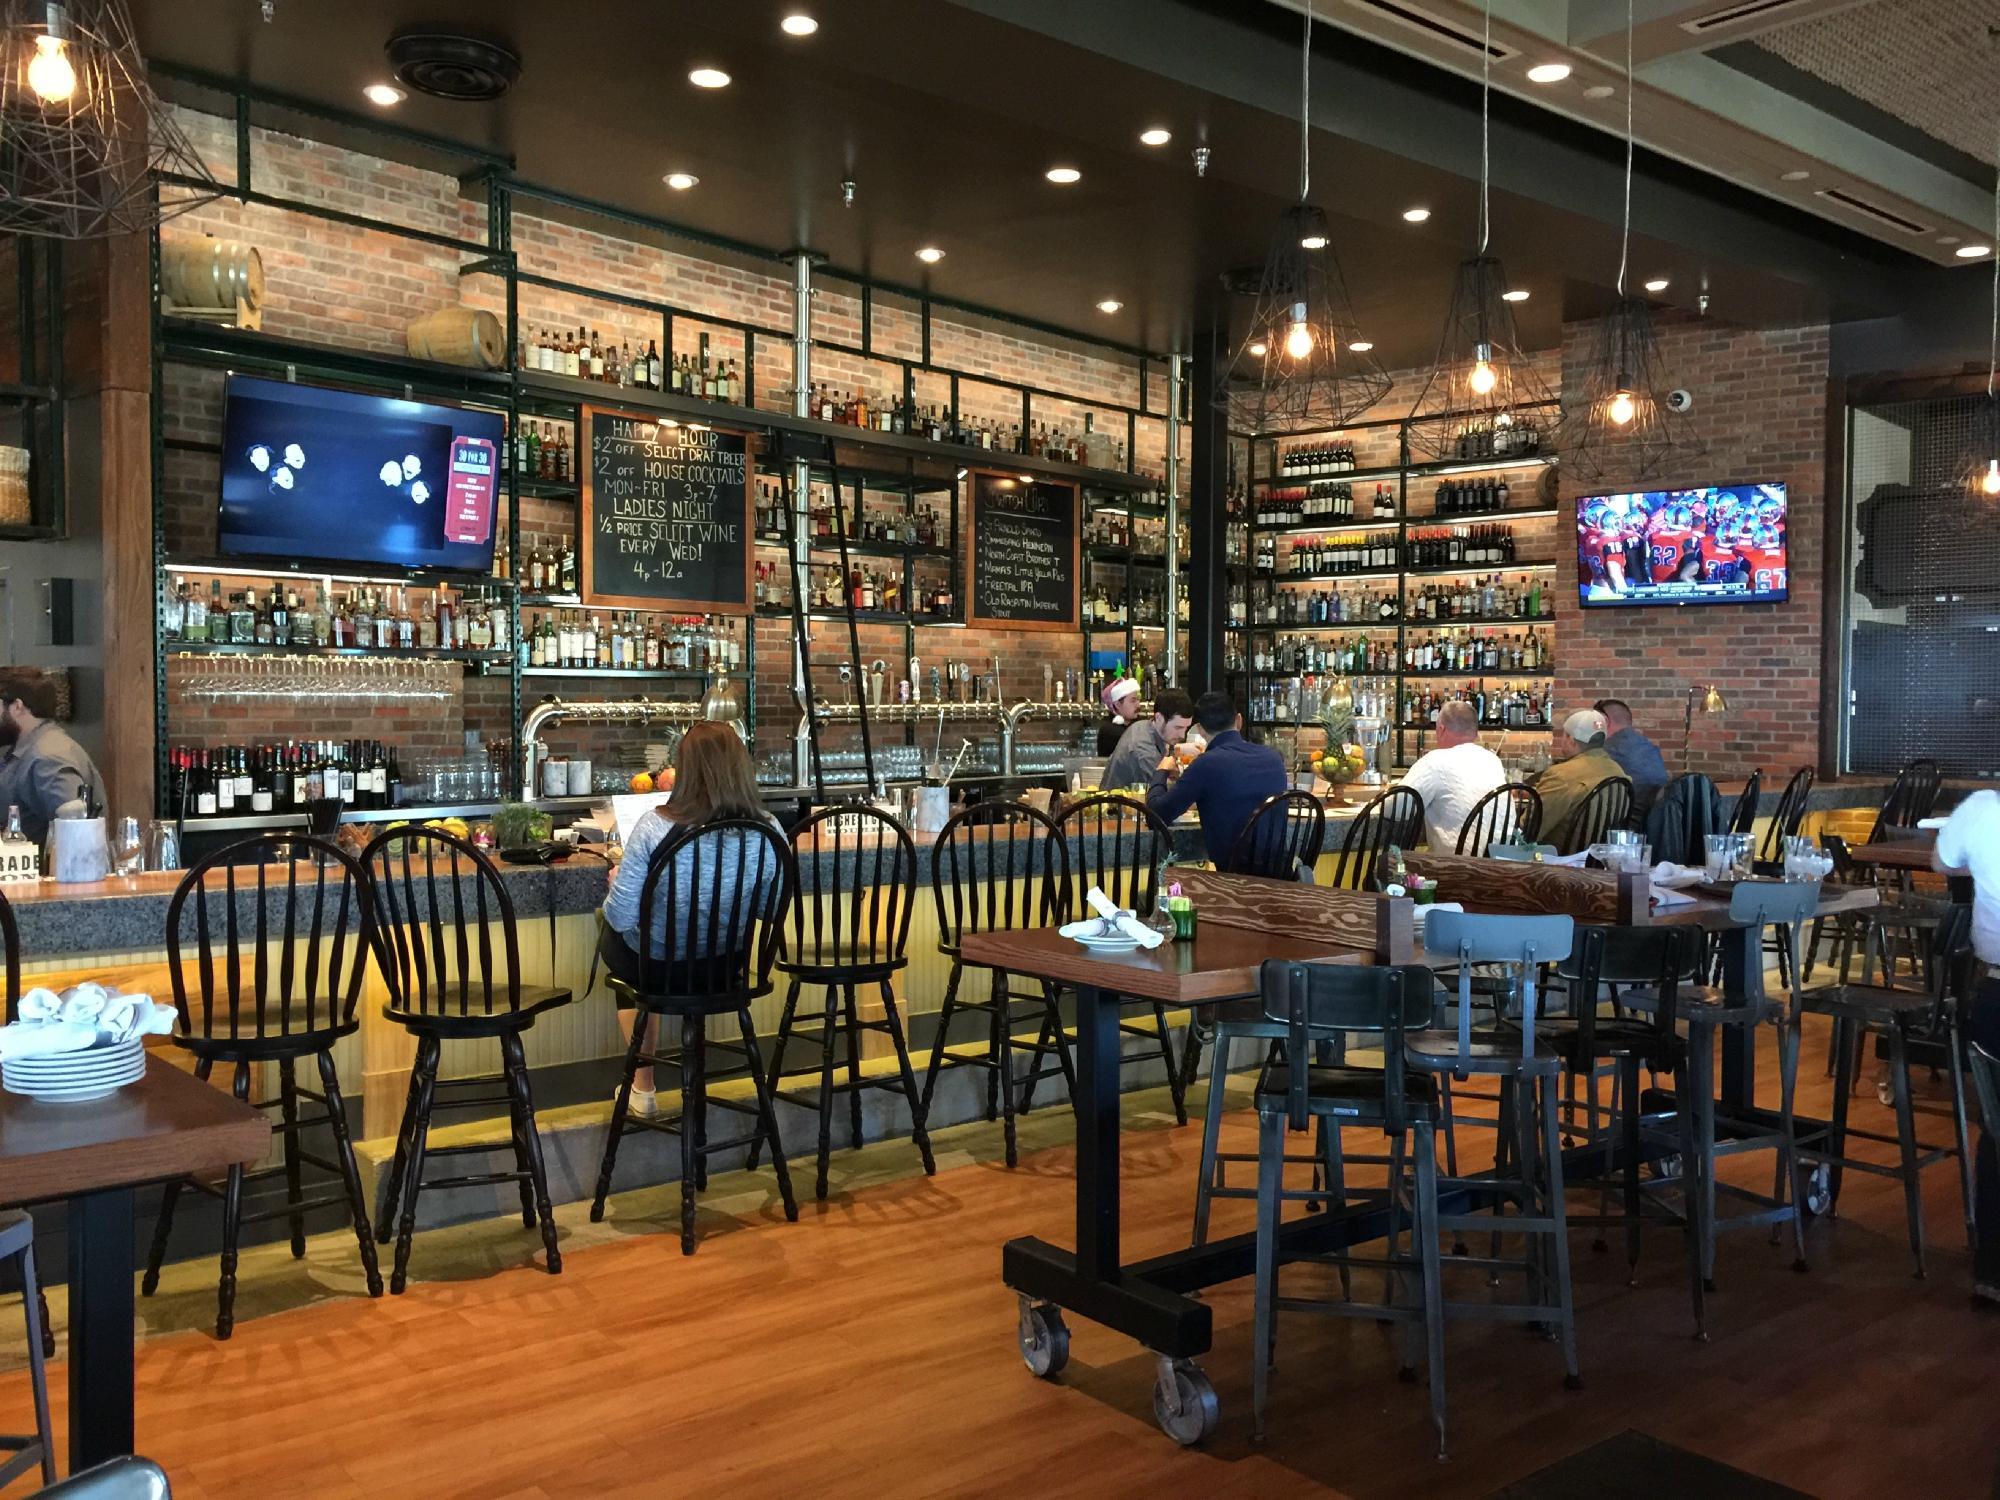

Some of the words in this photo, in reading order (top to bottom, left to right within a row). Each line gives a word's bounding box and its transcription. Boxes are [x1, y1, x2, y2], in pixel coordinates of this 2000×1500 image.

[613, 420, 660, 441] HAPPY
[678, 428, 718, 447] HOUR
[593, 437, 612, 453] $2
[616, 444, 636, 455] OFF
[643, 444, 686, 460] SELECT
[594, 457, 612, 475] $2
[617, 466, 635, 477] OFF
[644, 462, 686, 480] HOUSE
[688, 465, 746, 485] COCKTAILS
[613, 498, 667, 518] LADIES
[672, 501, 715, 521] NIGHT
[616, 522, 643, 537] PRICE
[649, 522, 694, 542] SELECT
[699, 524, 737, 543] WINE
[620, 538, 657, 556] EVERY
[669, 541, 703, 562] WED!
[827, 814, 868, 827] HIGHET
[0, 873, 37, 881] ON
